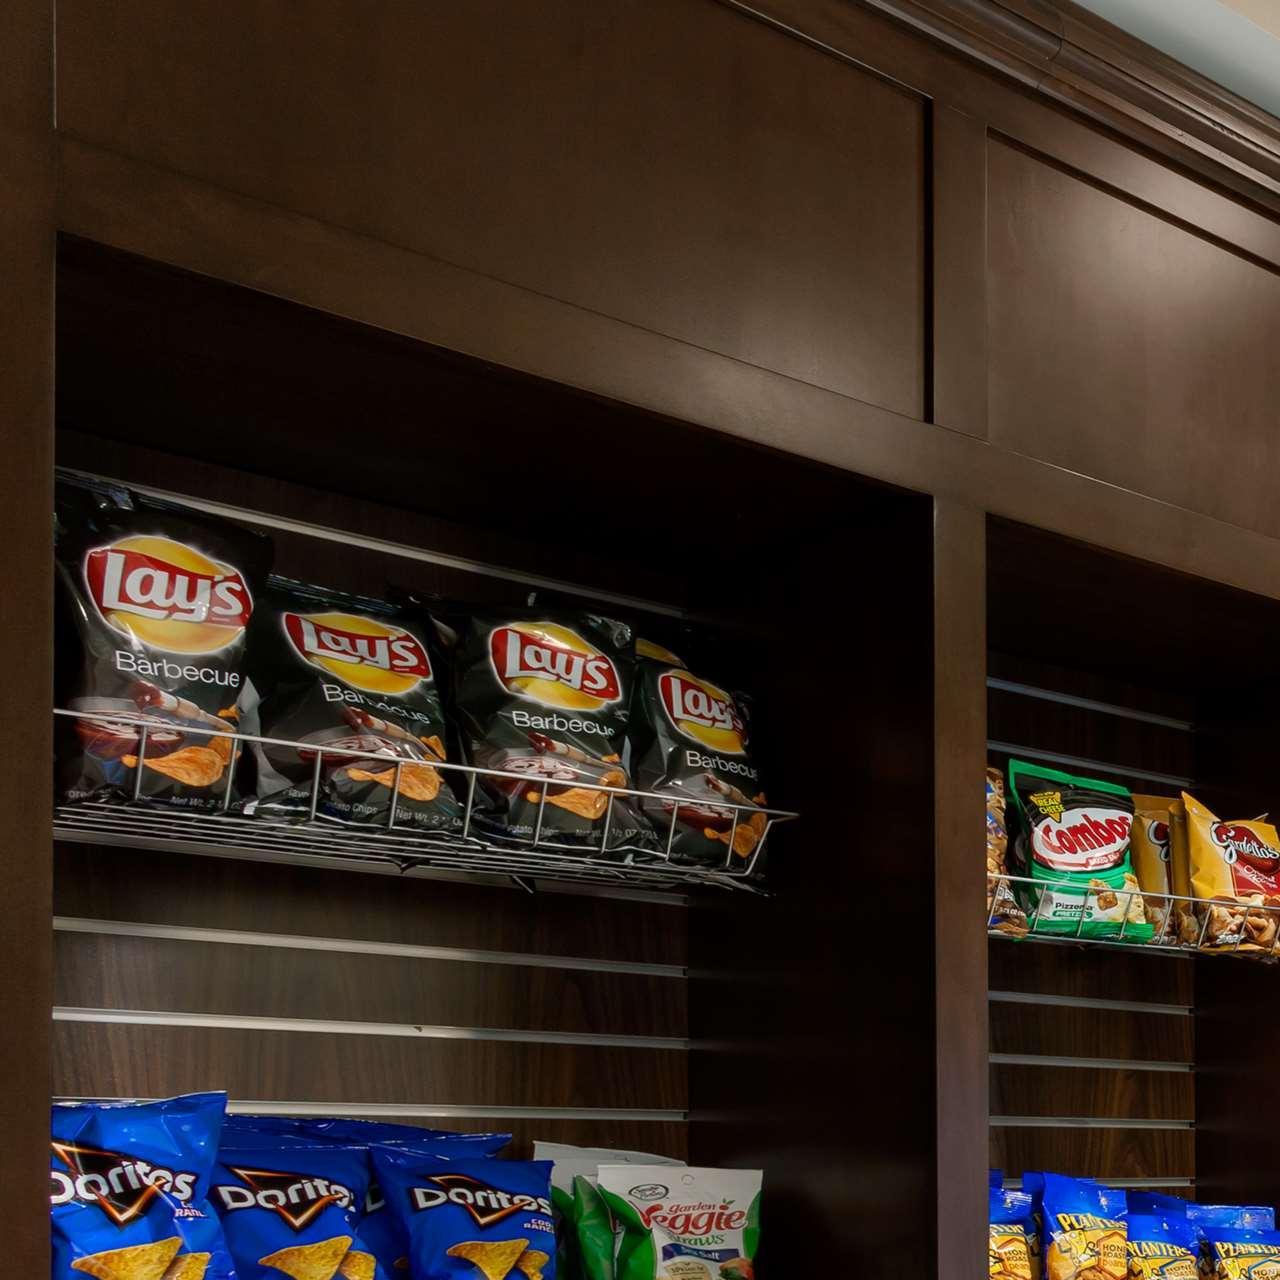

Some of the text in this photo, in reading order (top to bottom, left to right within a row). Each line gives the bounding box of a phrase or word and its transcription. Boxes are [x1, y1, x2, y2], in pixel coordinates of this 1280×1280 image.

[102, 552, 244, 622] Lay's
[115, 651, 240, 688] Barbecue
[301, 621, 419, 670] Lay's
[504, 630, 610, 690] Lay's
[1042, 813, 1131, 855] Combos
